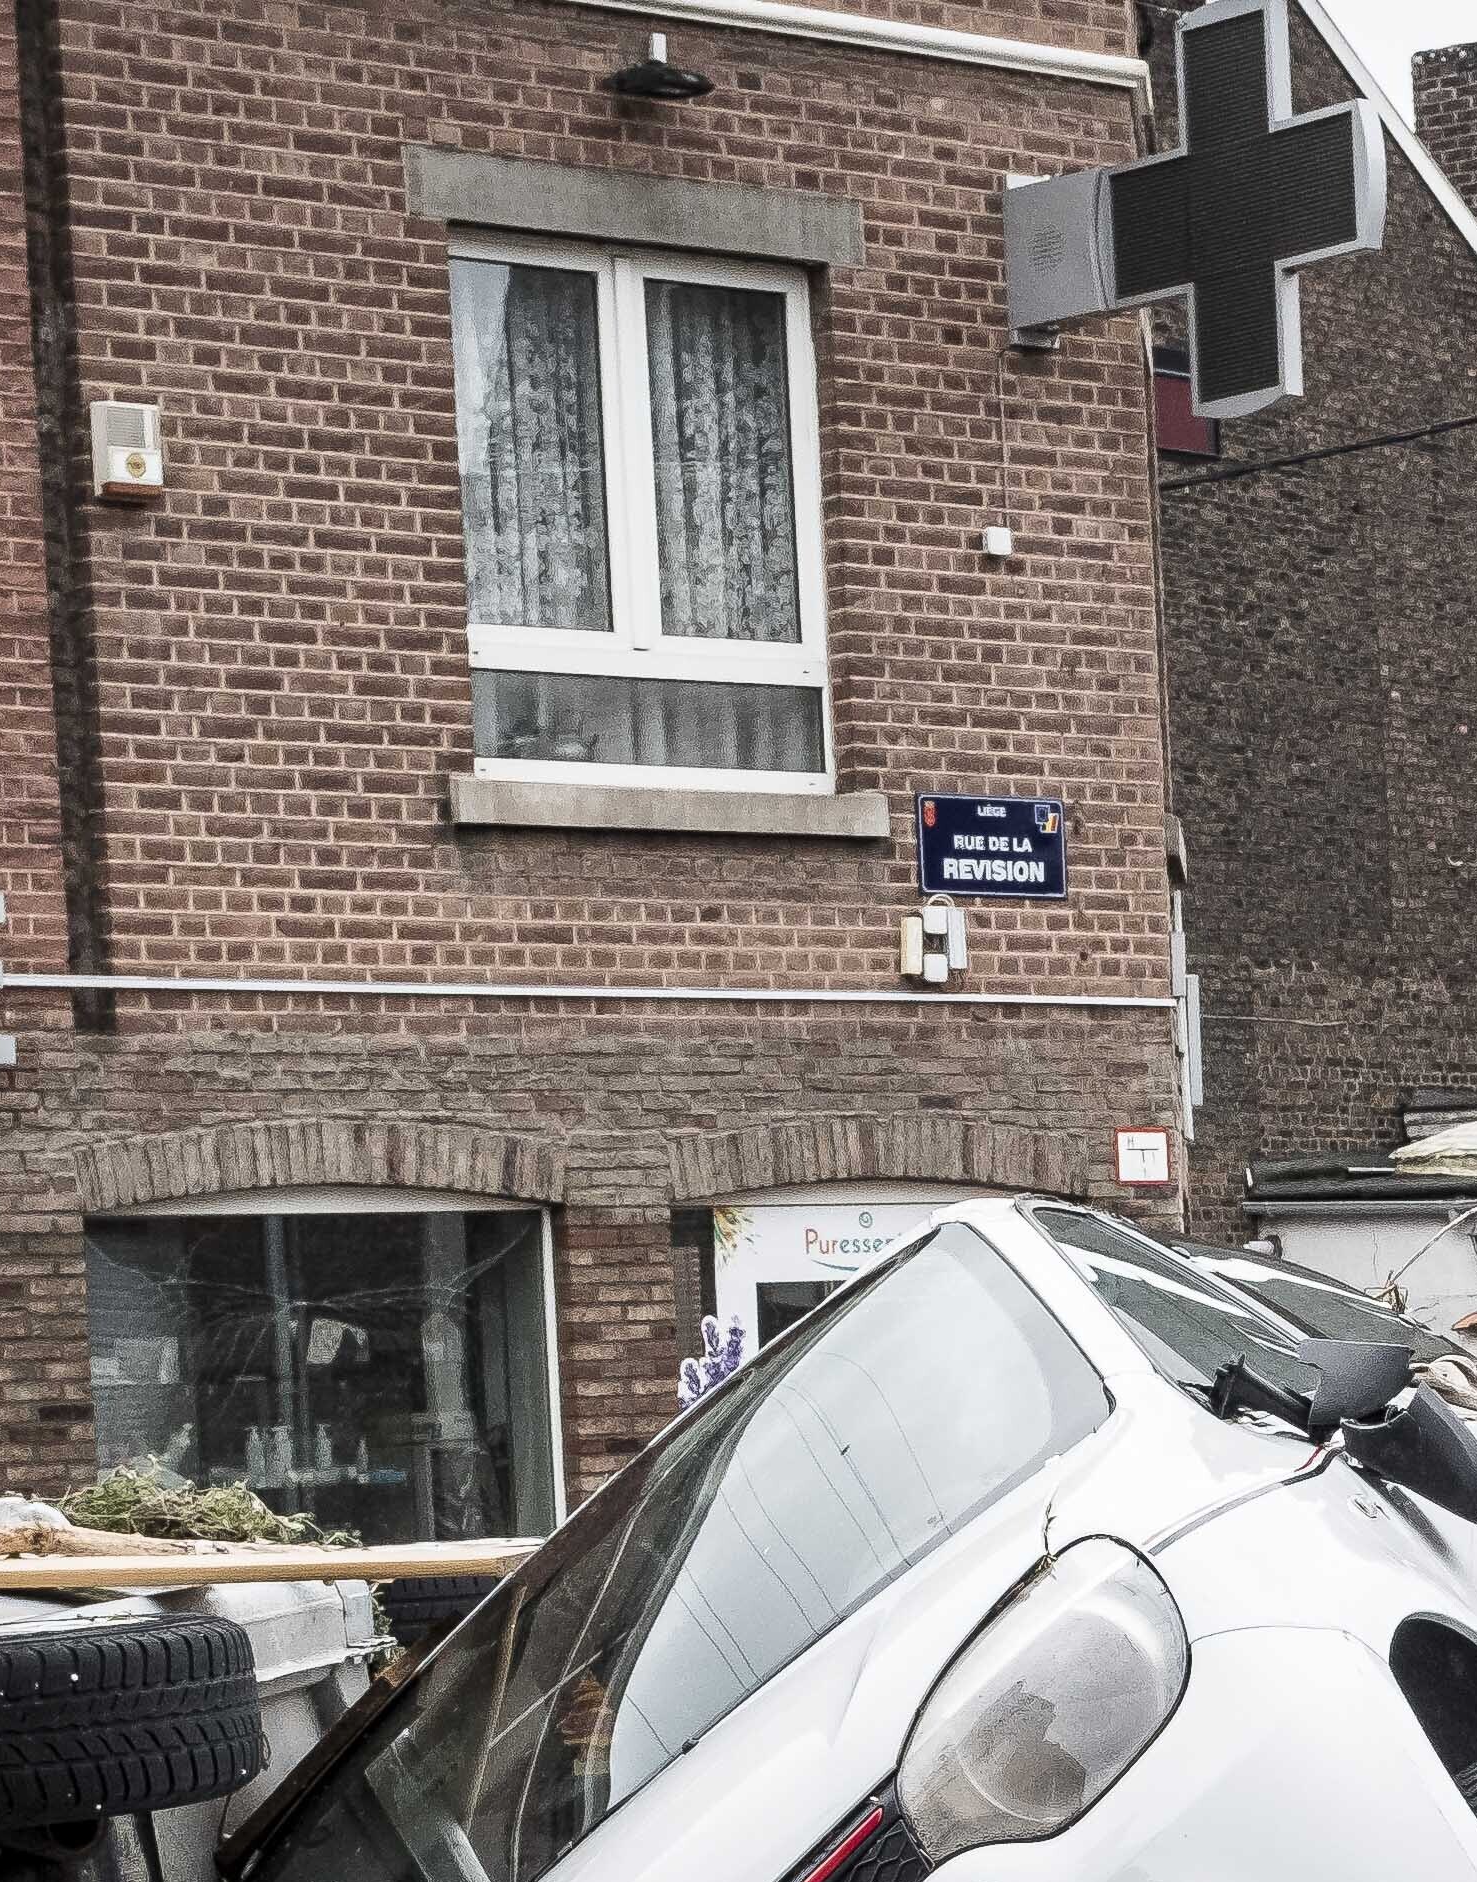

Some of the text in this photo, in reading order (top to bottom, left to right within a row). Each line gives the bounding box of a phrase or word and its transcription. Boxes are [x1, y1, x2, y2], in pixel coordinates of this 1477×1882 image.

[954, 834, 1033, 853] RUE DE LA
[943, 857, 1045, 883] REVISION
[805, 1228, 895, 1255] Puresse
